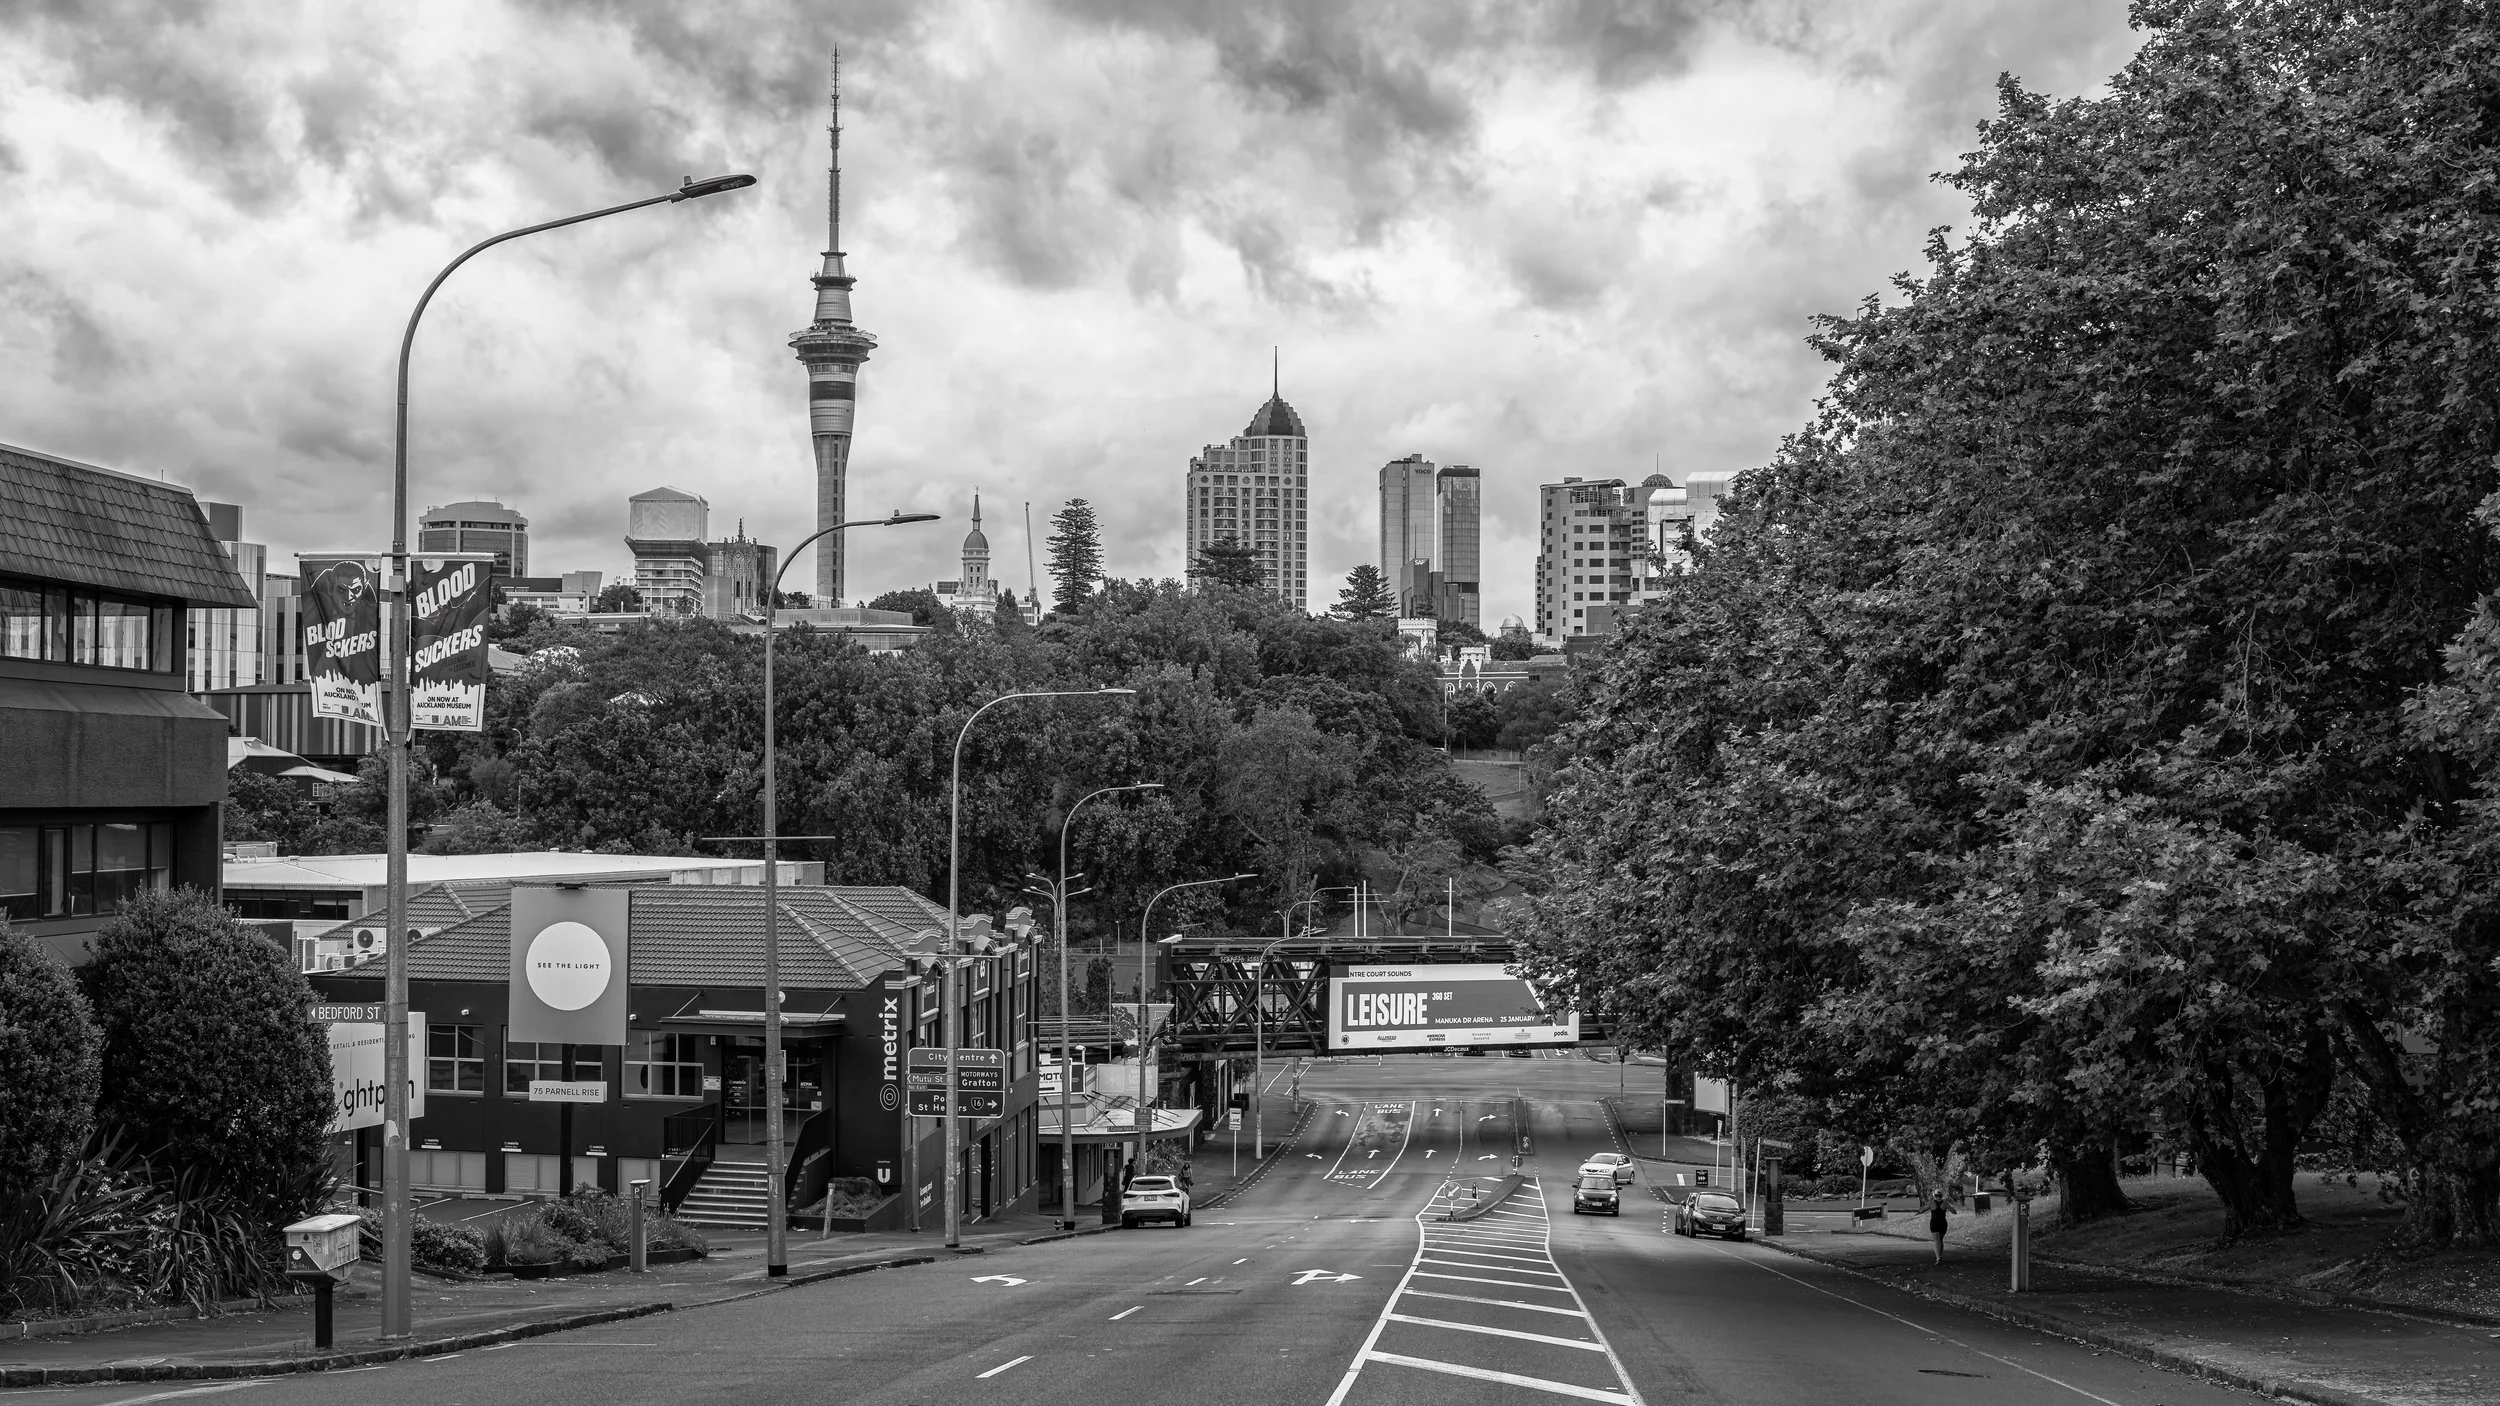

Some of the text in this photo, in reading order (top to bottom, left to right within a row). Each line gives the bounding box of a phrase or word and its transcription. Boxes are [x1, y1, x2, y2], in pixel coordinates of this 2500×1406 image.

[416, 562, 475, 619] BLOOD
[415, 624, 483, 673] SUCKERS
[324, 691, 356, 701] AUCKLAND
[345, 688, 357, 696] NO
[446, 702, 472, 710] MUSEUM
[318, 1006, 380, 1020] BEDFORD ST
[1347, 991, 1453, 1027] LEISURE 360 SET
[1472, 1016, 1494, 1024] ARENA
[1507, 1015, 1536, 1023] JANUARY
[878, 997, 898, 1080] metrix
[333, 1042, 350, 1050] RETAIL
[358, 1038, 384, 1046] RESIDENTI
[928, 1053, 985, 1062] City entre
[912, 1075, 943, 1083] Mutu St
[961, 1078, 997, 1087] Grafton
[533, 1087, 600, 1096] 75 PARNELL RISE
[933, 1094, 982, 1107] Po 16
[918, 1103, 967, 1112] St Hers
